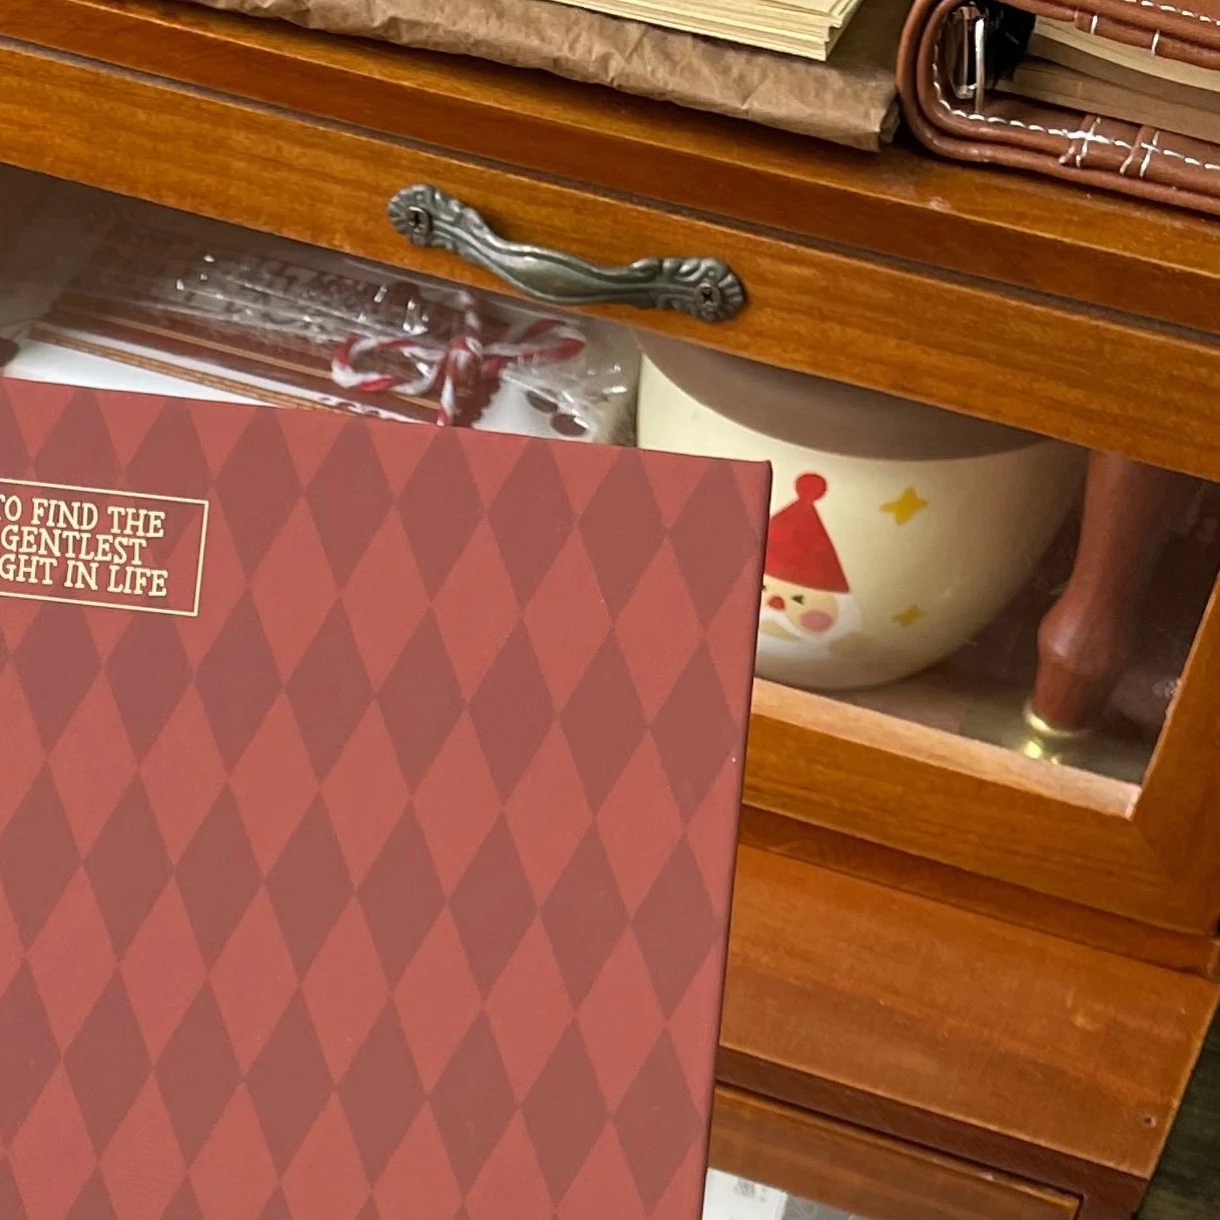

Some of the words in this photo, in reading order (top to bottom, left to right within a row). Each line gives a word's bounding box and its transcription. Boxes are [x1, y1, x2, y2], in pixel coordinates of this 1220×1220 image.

[31, 497, 98, 530] FIND
[107, 506, 166, 538] THE
[0, 524, 147, 566] GENTLEST
[64, 560, 99, 591] IN
[107, 564, 168, 597] LIFE
